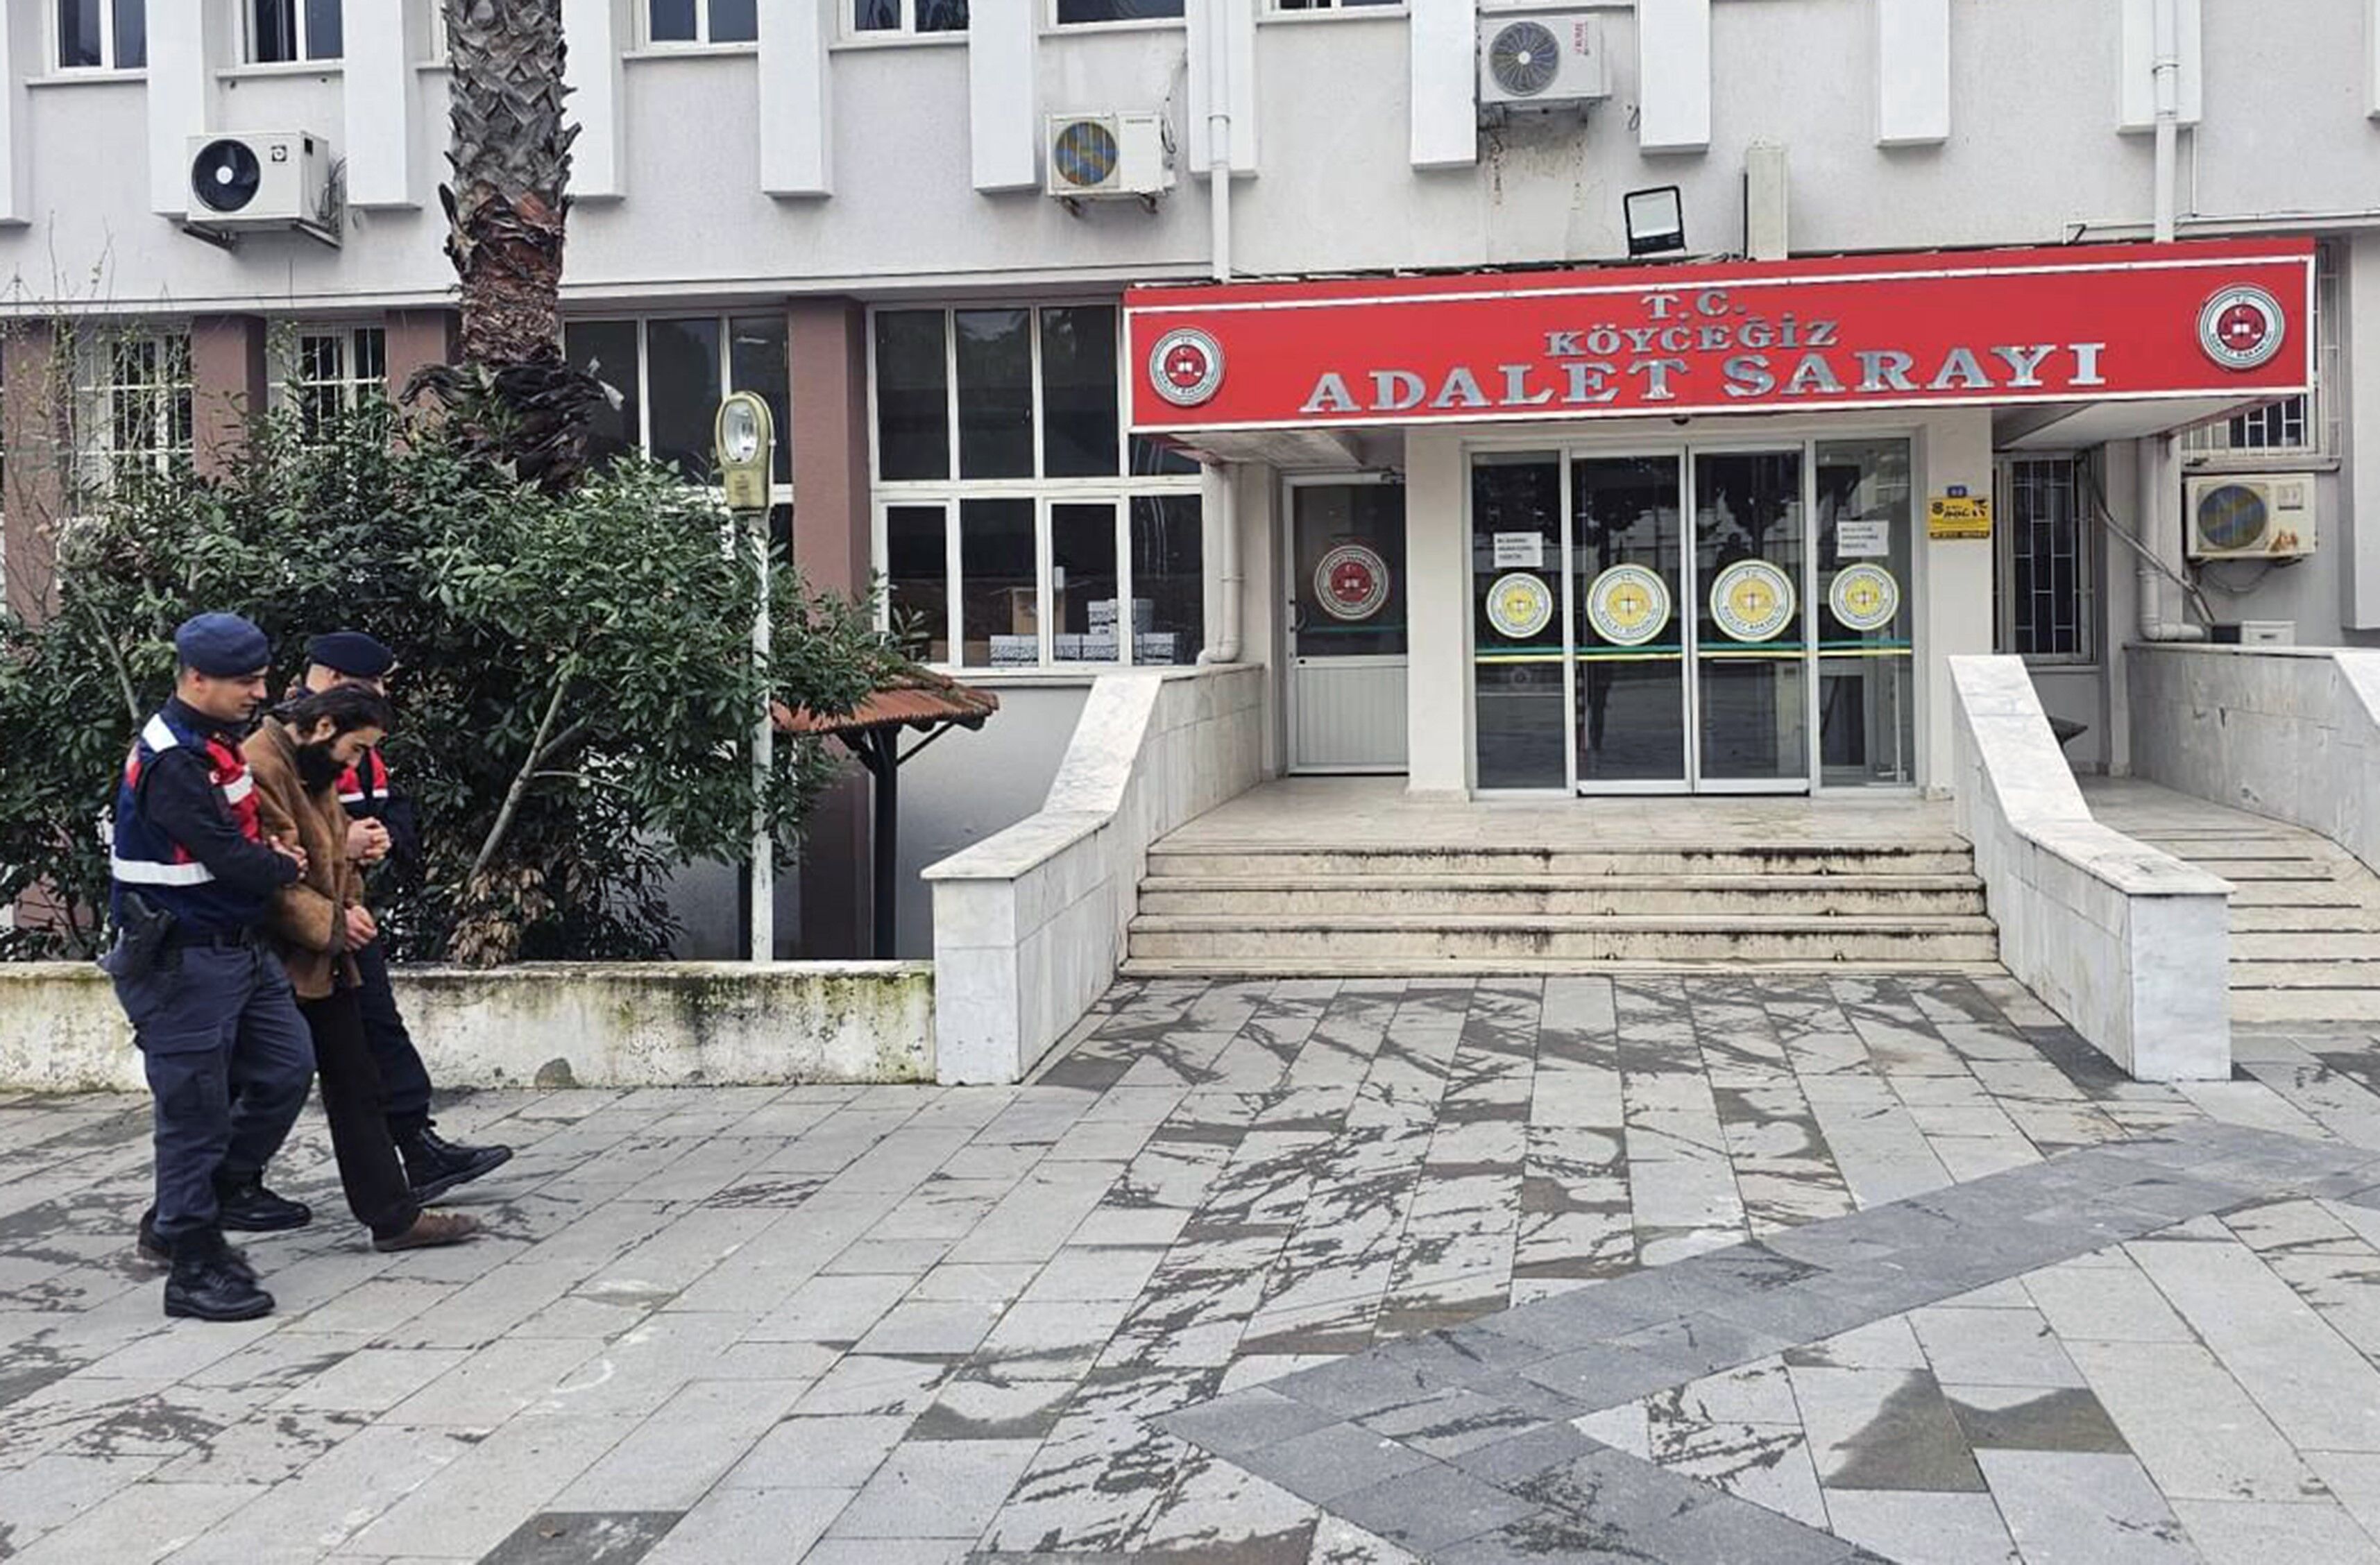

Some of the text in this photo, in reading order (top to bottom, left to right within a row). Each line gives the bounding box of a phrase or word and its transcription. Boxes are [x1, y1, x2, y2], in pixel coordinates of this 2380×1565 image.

[1640, 290, 1746, 320] T.C.
[1544, 312, 1838, 357] KÖYCEĞİZ
[1300, 343, 2107, 413] ADALET SARAYI
